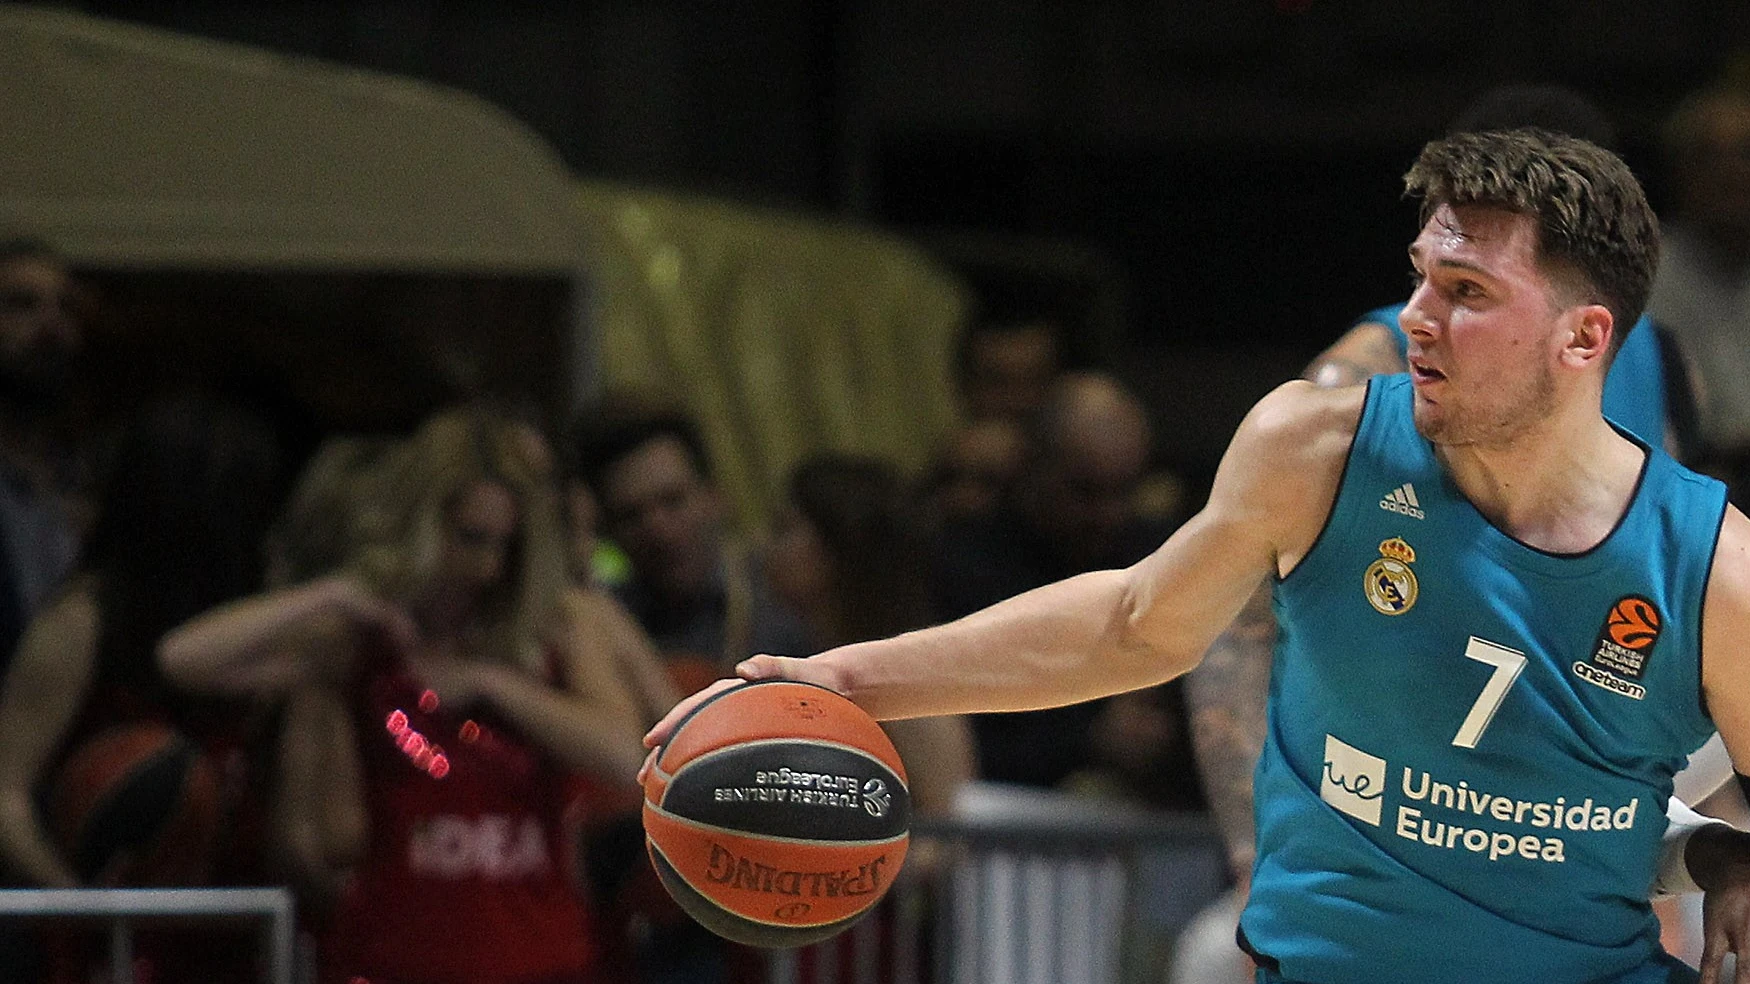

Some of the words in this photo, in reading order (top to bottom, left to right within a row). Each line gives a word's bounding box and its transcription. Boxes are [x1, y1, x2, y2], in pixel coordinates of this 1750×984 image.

[1380, 499, 1424, 520] adidas
[1597, 647, 1642, 670] AIRLINES
[1602, 639, 1645, 662] TURKISH
[1451, 634, 1529, 749] 7
[714, 787, 788, 803] AIRLINES
[790, 789, 859, 809] TURKISH
[1401, 766, 1639, 832] Universidad
[1395, 804, 1566, 864] Europea
[707, 843, 886, 897] SPALDING
